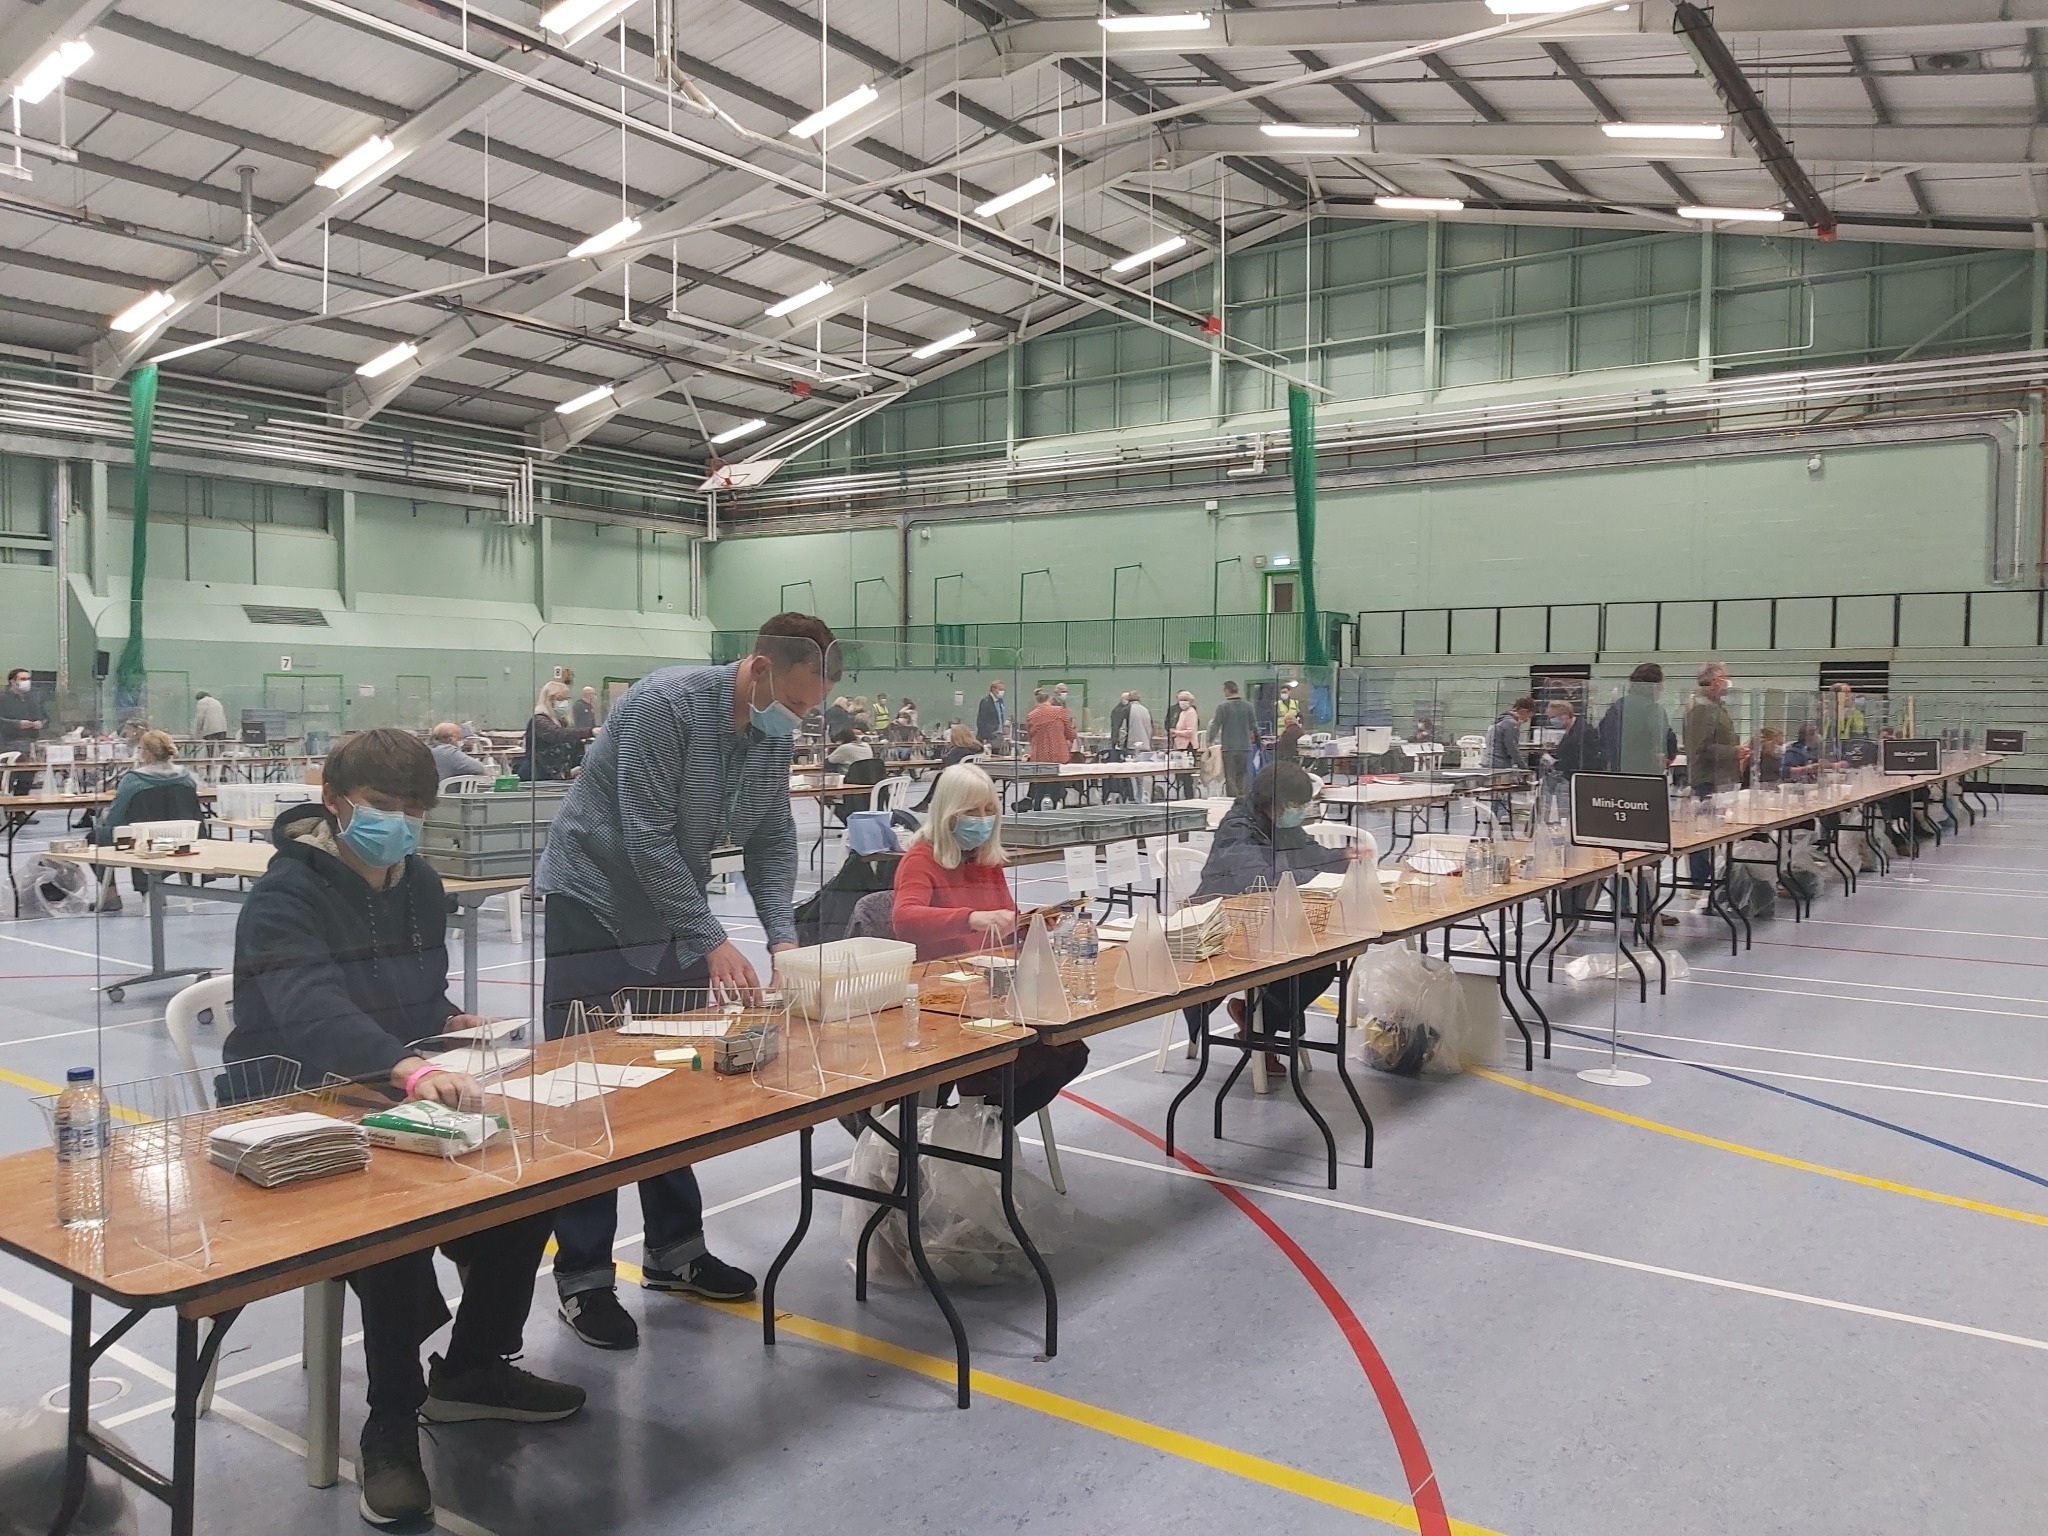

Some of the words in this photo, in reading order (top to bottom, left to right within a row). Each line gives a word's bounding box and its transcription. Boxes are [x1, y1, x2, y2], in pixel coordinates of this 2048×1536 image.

[283, 658, 289, 668] 7
[1592, 797, 1650, 811] Mini-Count
[1613, 811, 1627, 822] 13
